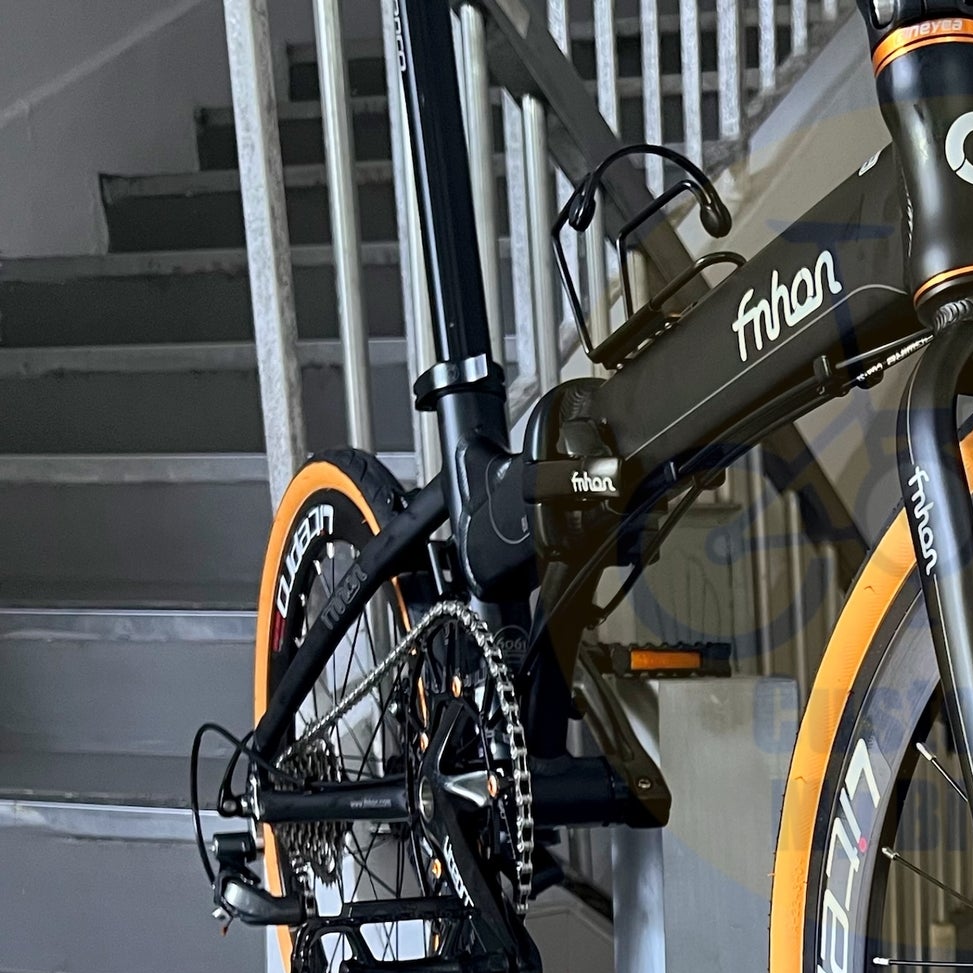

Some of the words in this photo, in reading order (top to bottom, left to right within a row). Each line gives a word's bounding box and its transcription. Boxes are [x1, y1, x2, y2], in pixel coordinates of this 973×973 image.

[731, 250, 842, 362] fnhon
[571, 472, 616, 492] fnhon
[908, 466, 937, 576] fnhon
